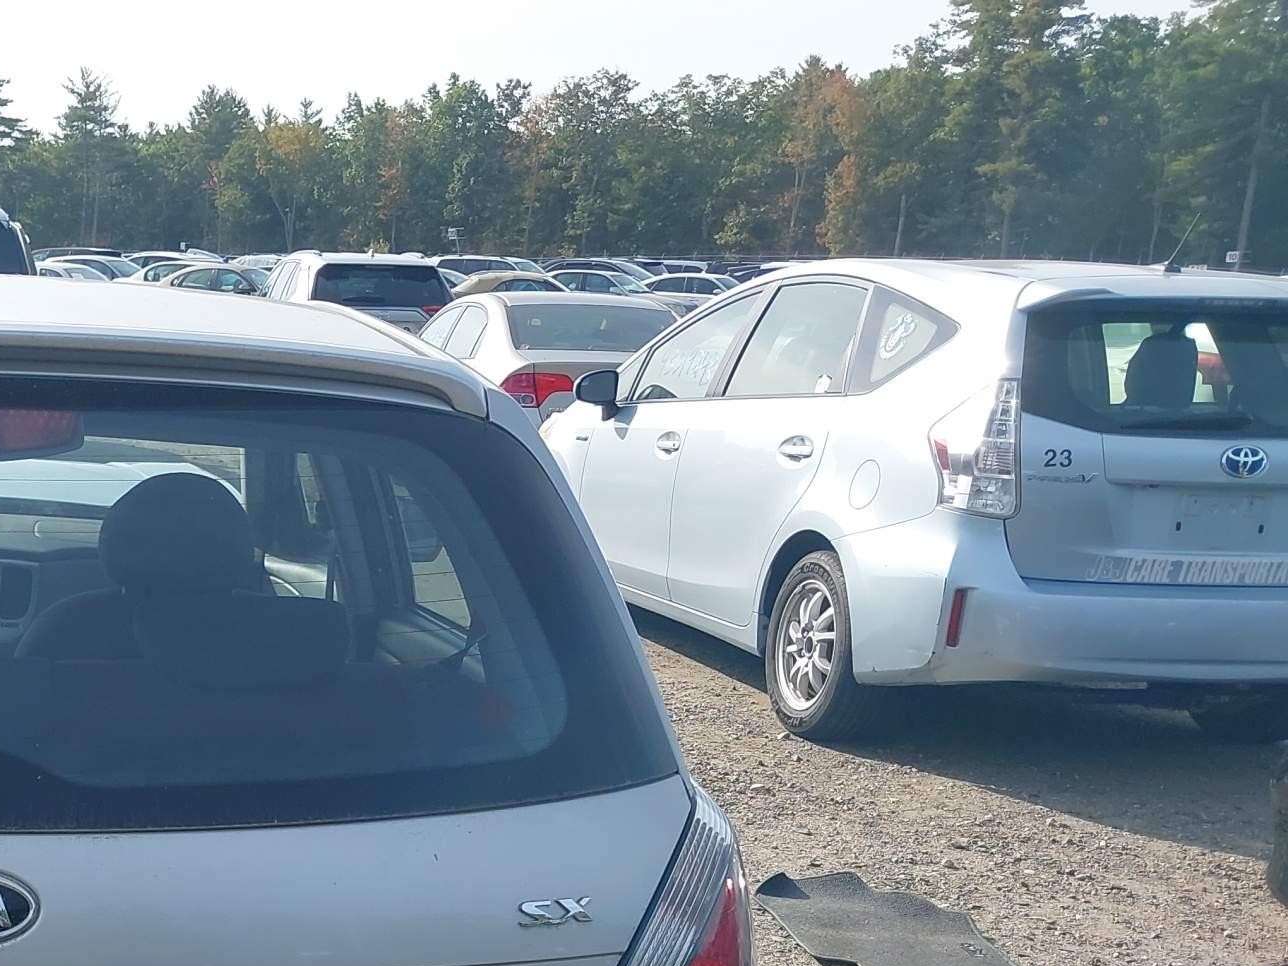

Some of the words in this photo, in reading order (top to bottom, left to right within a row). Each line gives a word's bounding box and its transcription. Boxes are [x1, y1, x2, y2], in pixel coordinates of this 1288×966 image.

[1043, 449, 1073, 468] 23
[1126, 558, 1176, 583] CARE
[518, 896, 593, 927] SX
